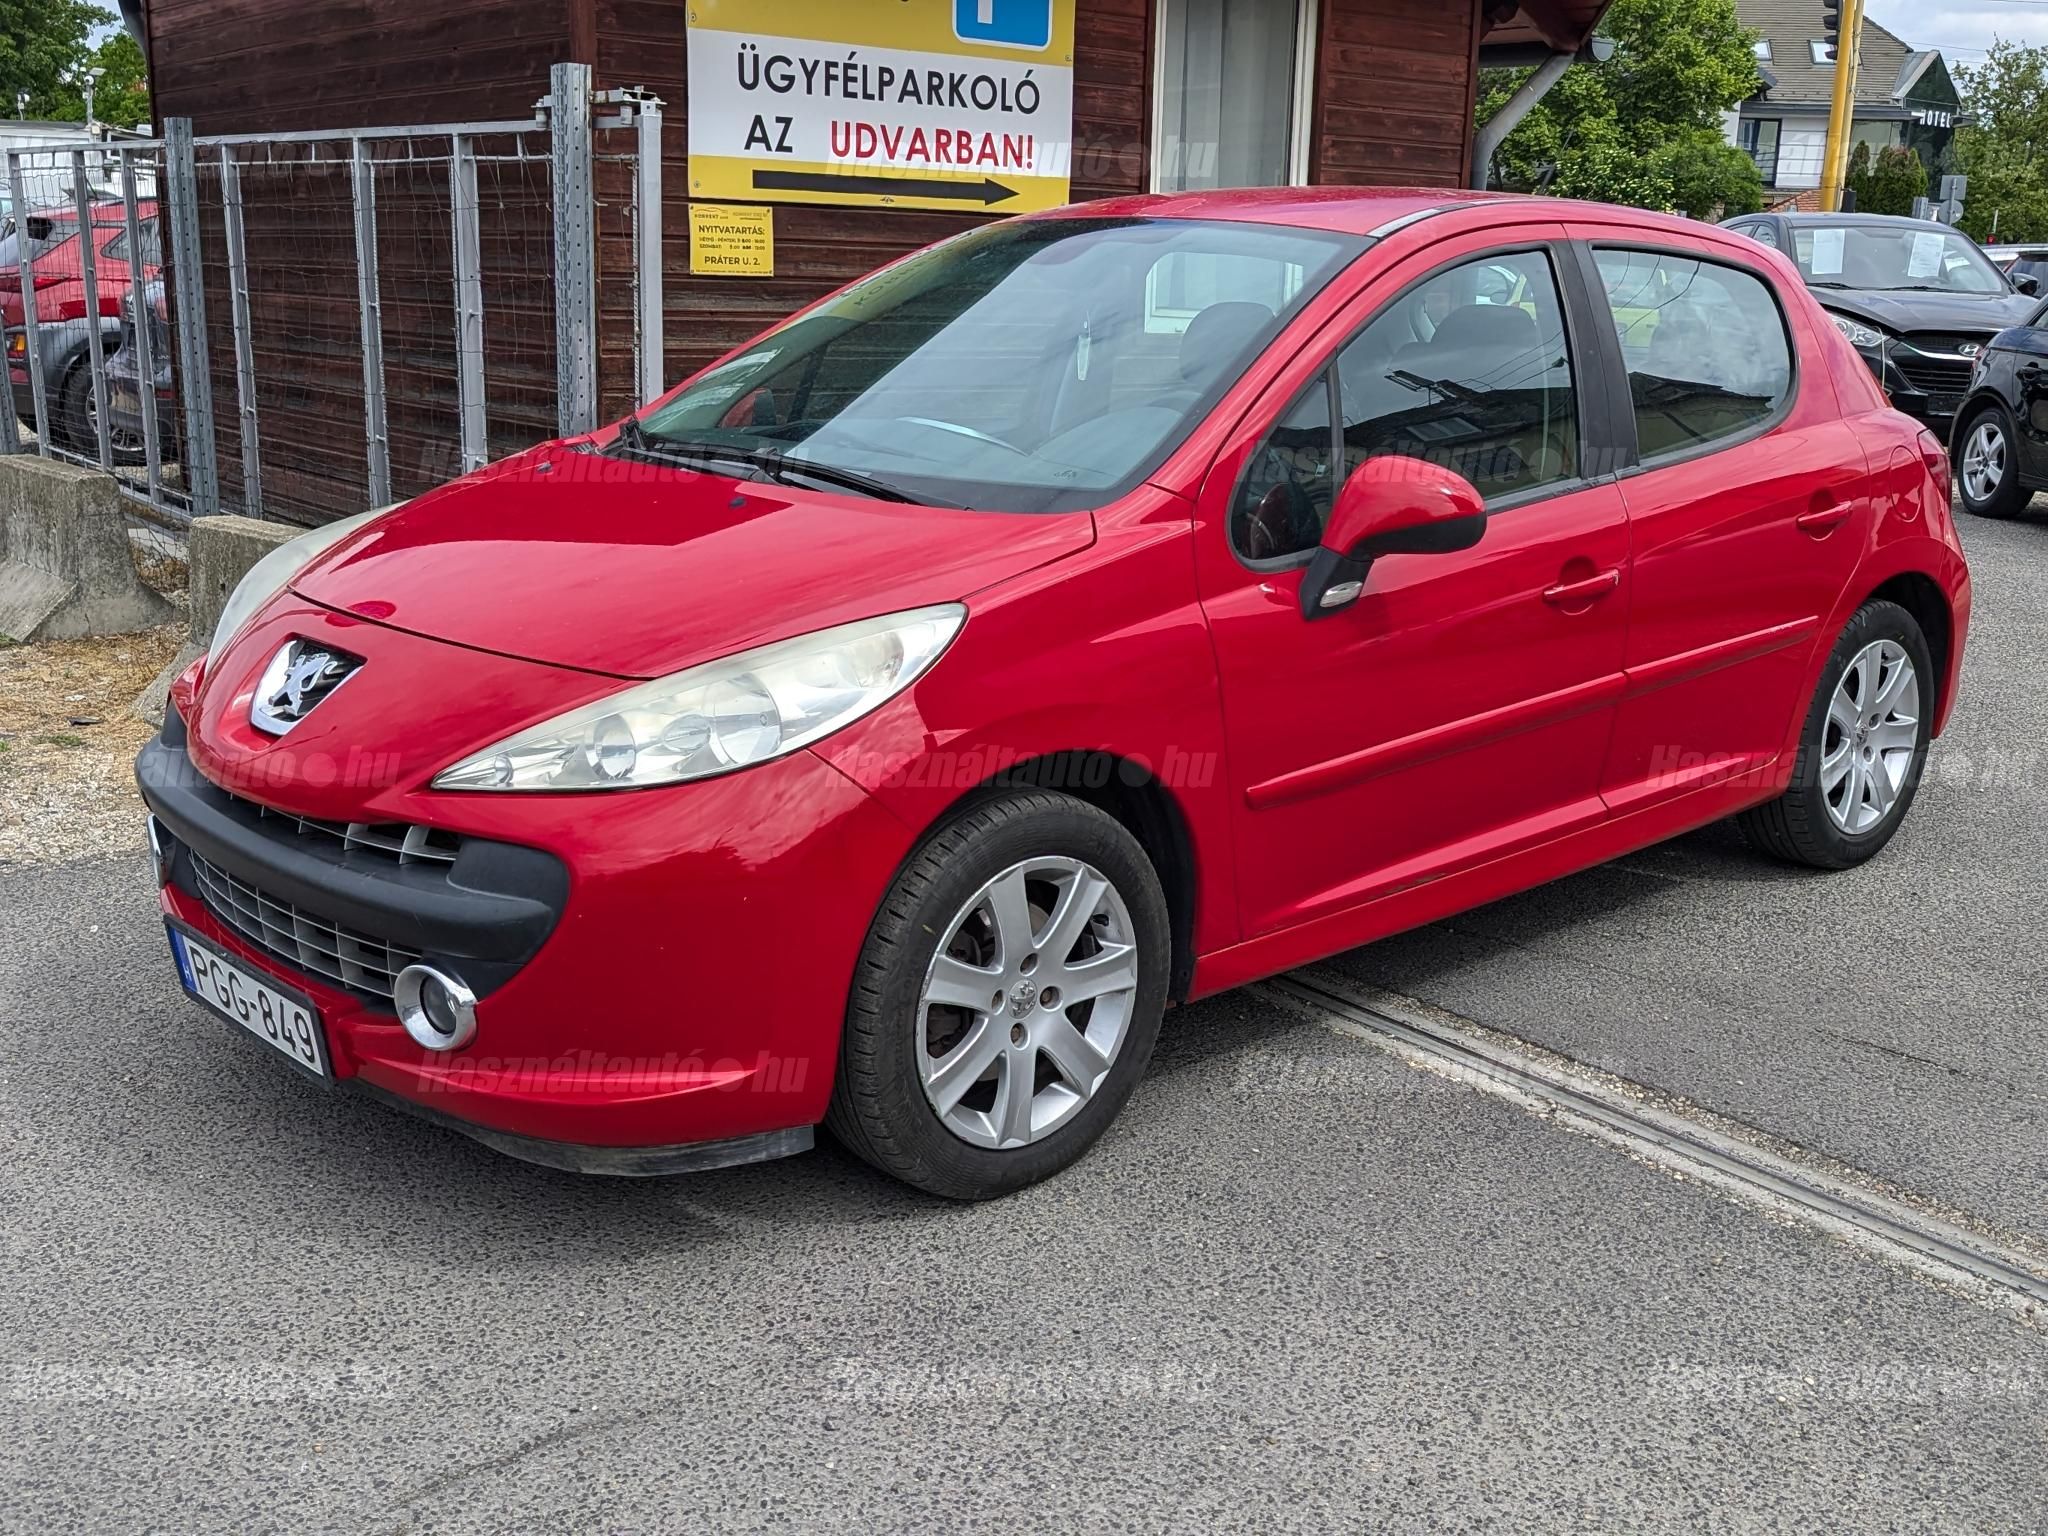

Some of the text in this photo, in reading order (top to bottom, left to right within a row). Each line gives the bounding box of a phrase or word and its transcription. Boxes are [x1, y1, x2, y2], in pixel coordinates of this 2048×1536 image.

[737, 42, 1040, 115] ÜGYFÉLPARKOLÓ
[743, 114, 1033, 169] AZ UDVARBAN!
[698, 224, 766, 236] NYITVATARTÁS:
[704, 254, 740, 265] PRÁTER
[189, 945, 315, 1063] PGG-849
